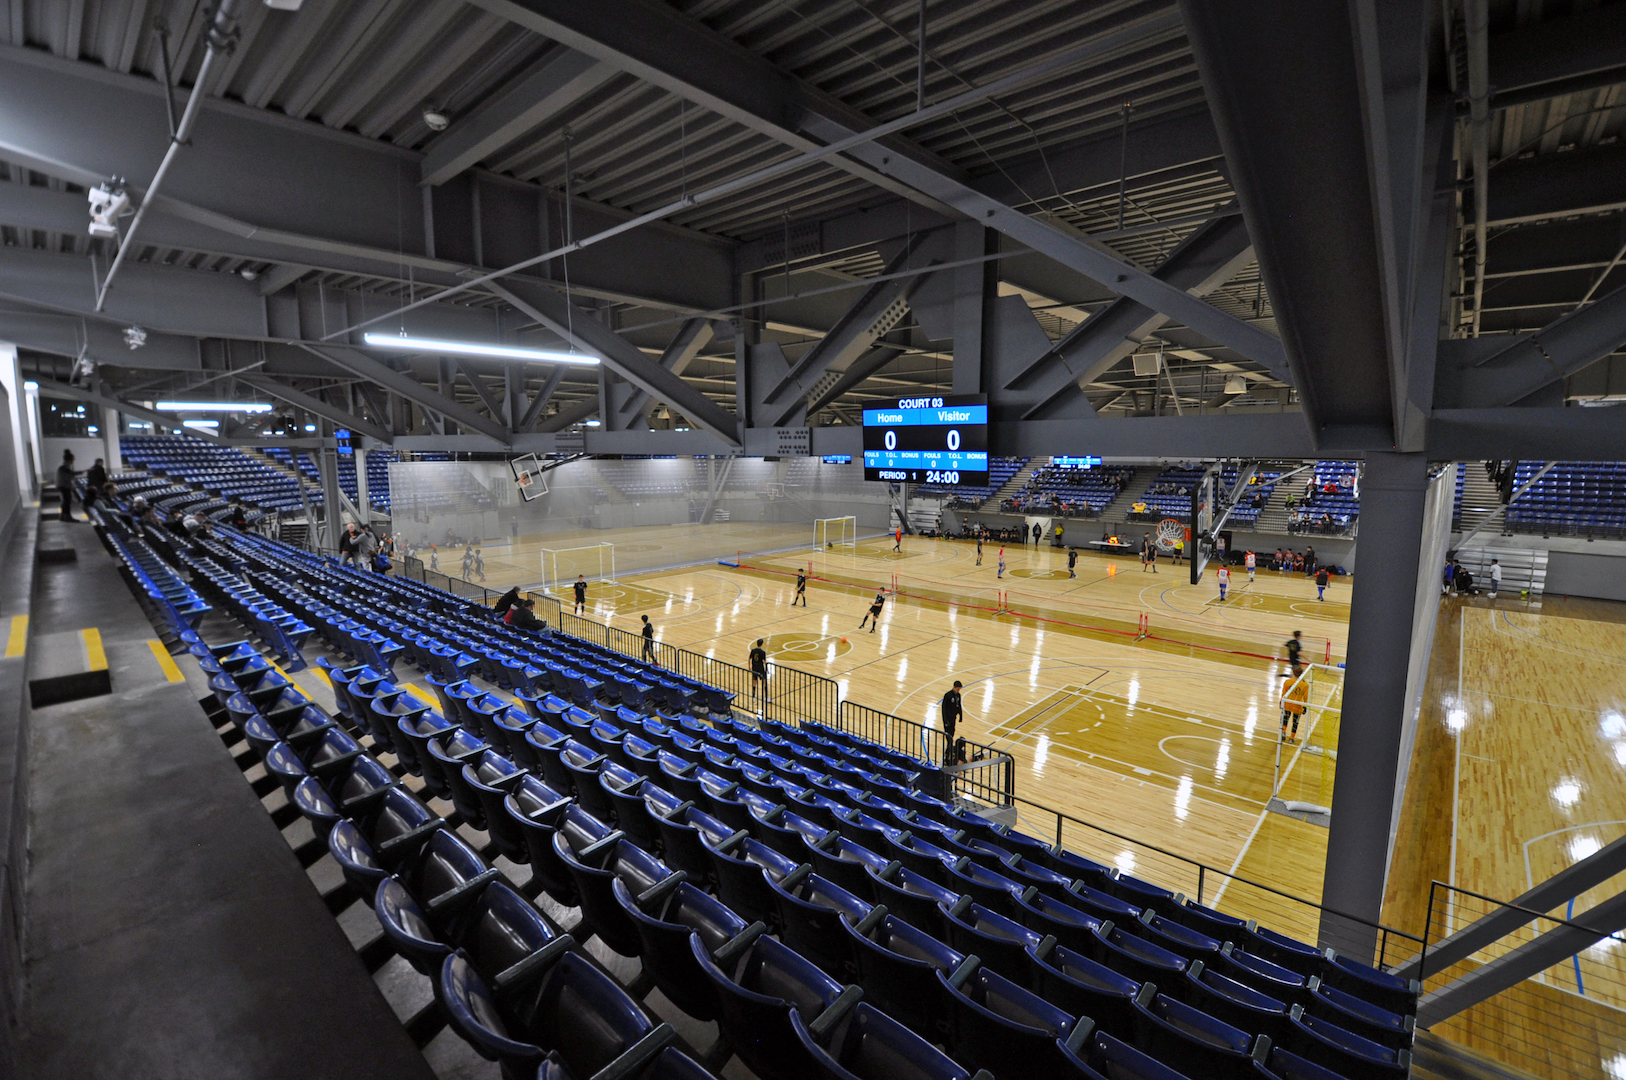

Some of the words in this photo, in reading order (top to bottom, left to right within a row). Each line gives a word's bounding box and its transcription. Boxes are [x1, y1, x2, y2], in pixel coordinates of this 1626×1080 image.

[898, 398, 931, 409] COURT
[931, 397, 944, 408] 03
[877, 413, 903, 423] Home
[938, 411, 970, 421] Visitor
[885, 431, 896, 450] 0
[947, 430, 960, 450] 0
[870, 458, 875, 466] 0
[888, 459, 893, 467] 0
[931, 459, 936, 468] 0
[952, 460, 958, 469] 0
[879, 470, 906, 480] PERIOD
[912, 472, 917, 480] 1
[926, 471, 959, 484] 24:00
[753, 653, 759, 662] 6
